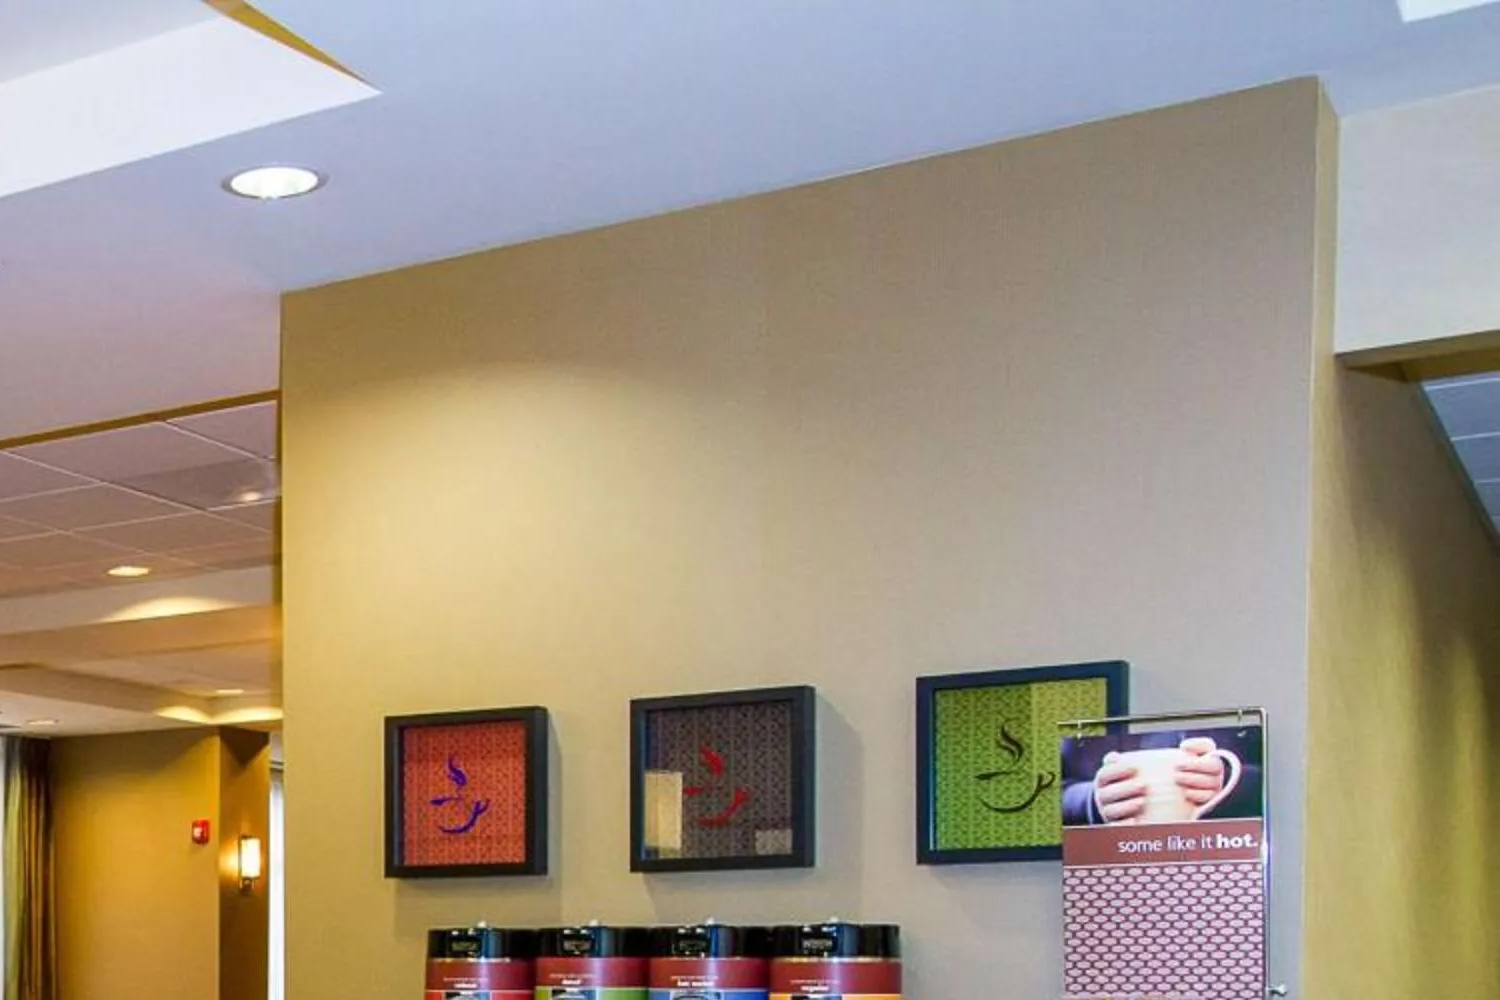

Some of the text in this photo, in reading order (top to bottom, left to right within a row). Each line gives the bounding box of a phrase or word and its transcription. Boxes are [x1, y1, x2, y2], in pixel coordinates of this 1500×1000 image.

[1116, 832, 1259, 853] some like it hot.
